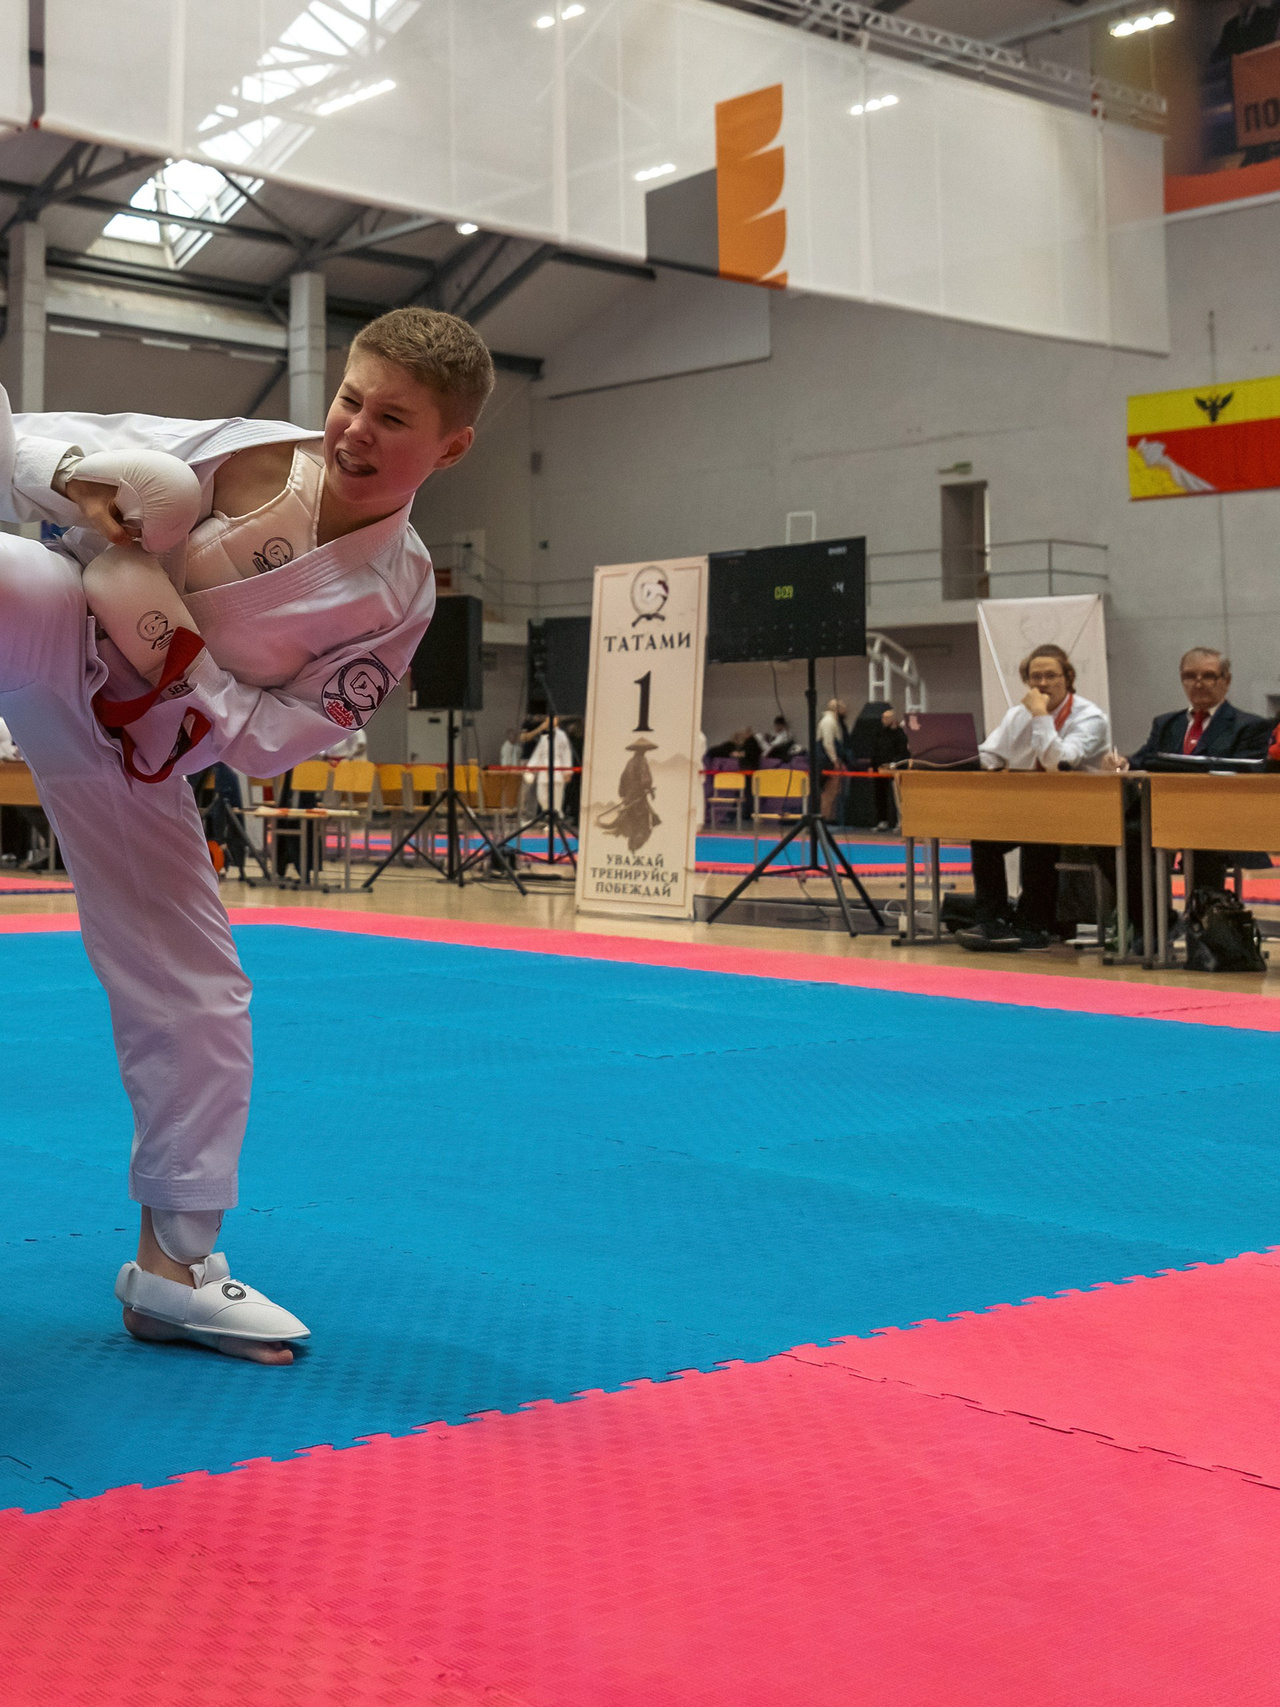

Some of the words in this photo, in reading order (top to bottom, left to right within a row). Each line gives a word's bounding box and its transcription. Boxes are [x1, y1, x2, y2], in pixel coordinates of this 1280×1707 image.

[603, 631, 691, 652] ТАТАМИ
[632, 669, 654, 732] 1
[606, 853, 665, 868] УВАЖАЙ
[590, 867, 679, 883] ТРЕНИРУЙСЯ
[595, 881, 671, 897] ПОБЕЖДАЙ
